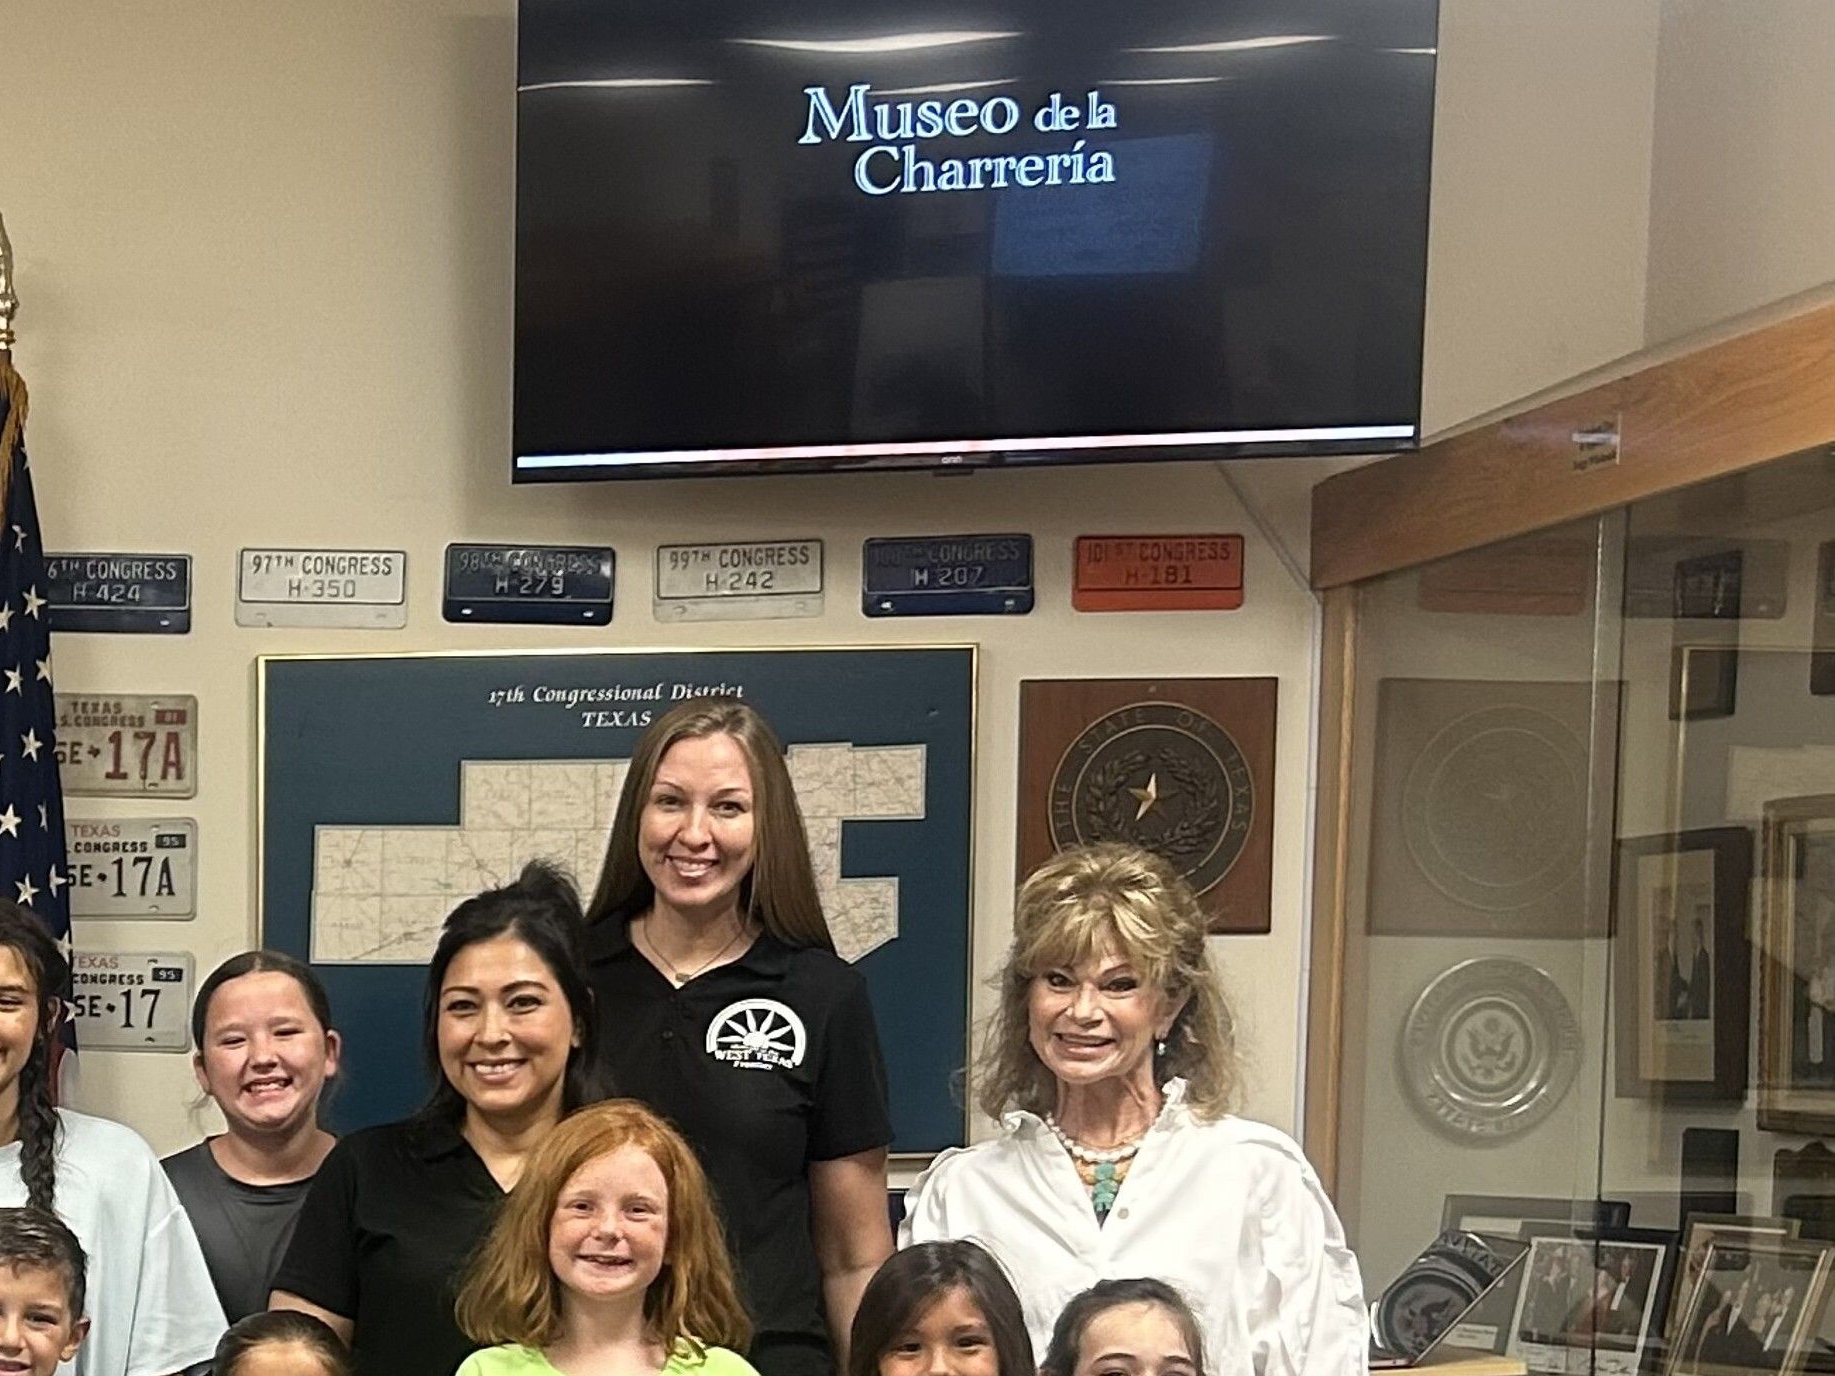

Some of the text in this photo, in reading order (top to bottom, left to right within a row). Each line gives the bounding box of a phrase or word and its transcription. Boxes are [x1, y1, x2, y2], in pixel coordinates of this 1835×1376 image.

[797, 84, 1117, 145] Museo de la
[854, 139, 1116, 195] Charrería
[669, 545, 811, 570] 99TH CONGRESS
[928, 541, 1021, 563] CONGRESS
[1139, 541, 1231, 562] CONGRESS
[47, 560, 177, 581] 6TH CONGRESS
[252, 555, 393, 576] 97TH CONGRESS
[487, 681, 744, 710] 17th Congressional District
[70, 702, 122, 715] TEXAS
[580, 710, 653, 728] TEXAS
[70, 824, 121, 838] TEXAS
[73, 841, 148, 854] CONGRESS
